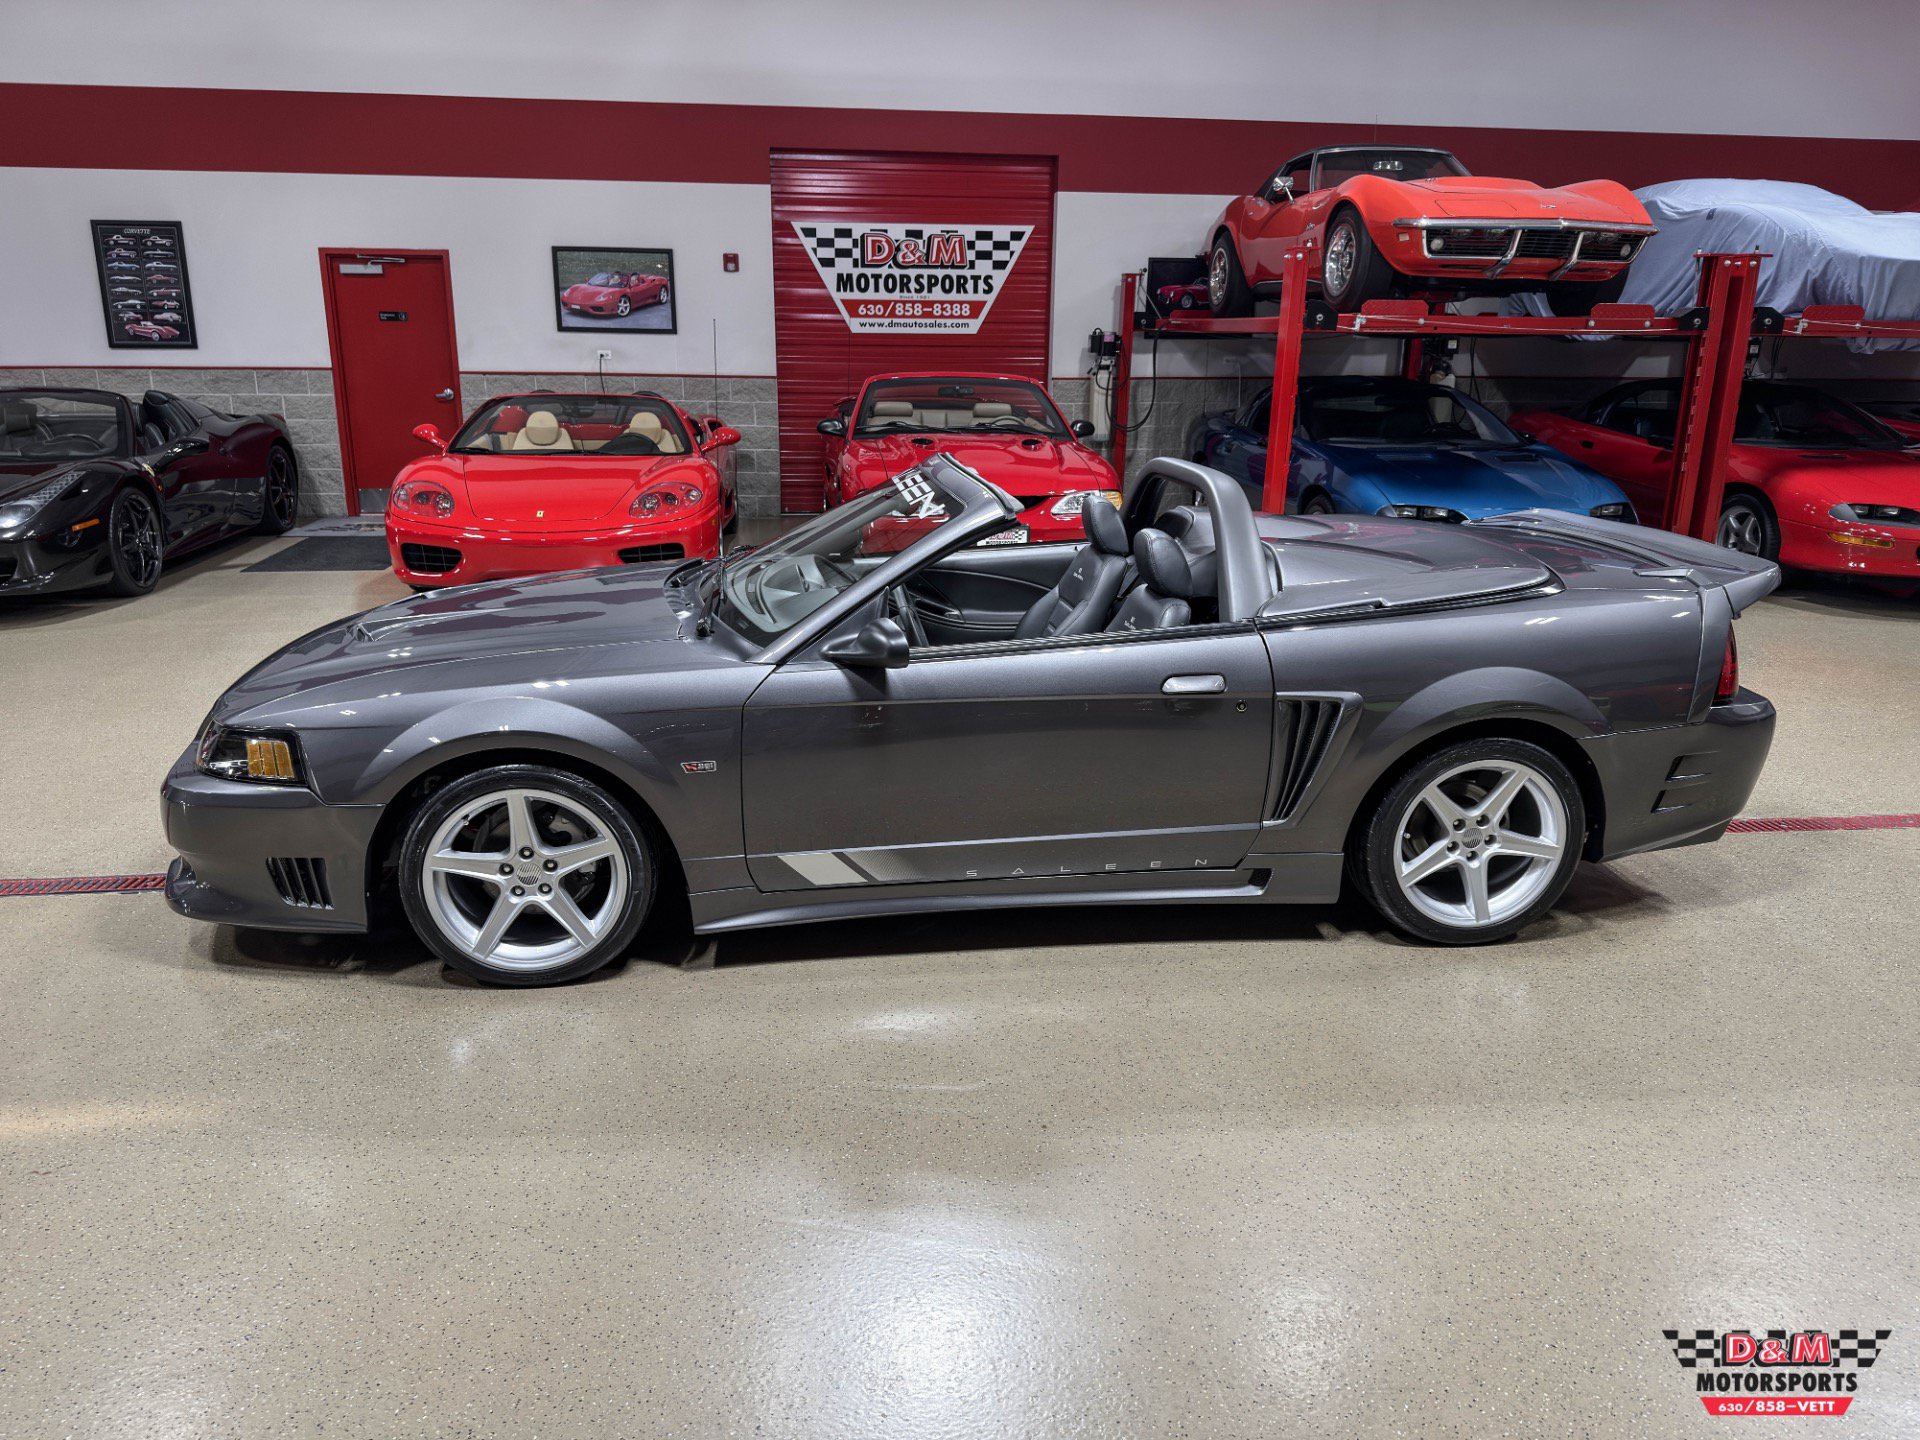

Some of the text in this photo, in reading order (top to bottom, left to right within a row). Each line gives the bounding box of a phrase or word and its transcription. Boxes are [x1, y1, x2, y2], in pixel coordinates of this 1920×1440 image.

[861, 233, 968, 269] D&M
[836, 273, 994, 295] MOTORSPORTS
[858, 302, 970, 317] 630/858-8388
[859, 320, 970, 329] www.dmautosales.com
[965, 858, 1208, 878] SALEEN
